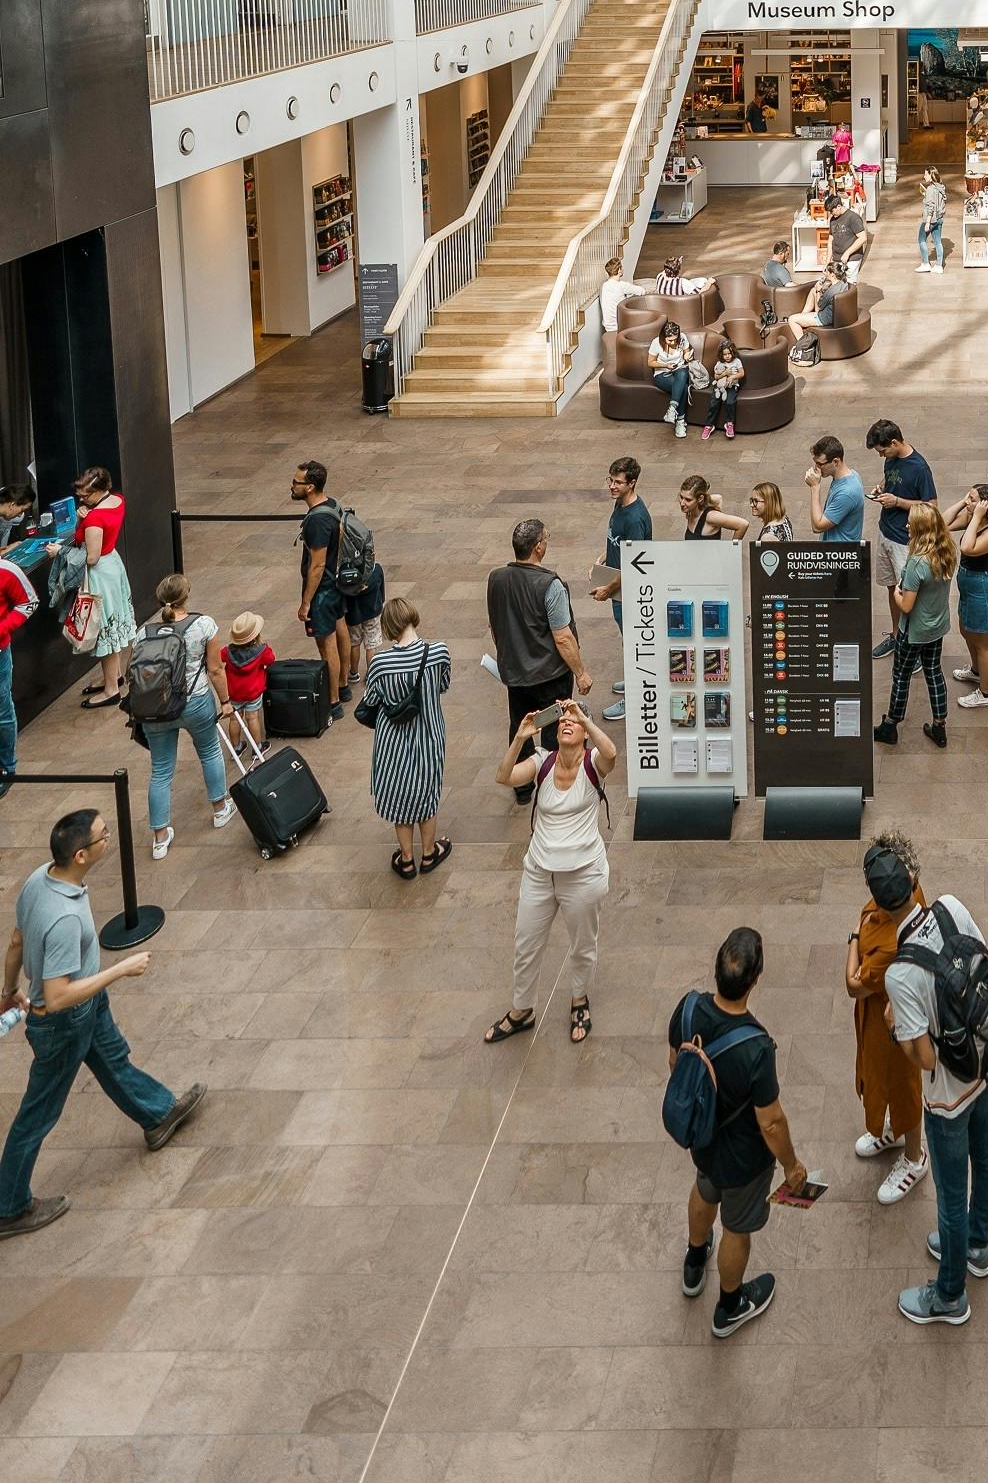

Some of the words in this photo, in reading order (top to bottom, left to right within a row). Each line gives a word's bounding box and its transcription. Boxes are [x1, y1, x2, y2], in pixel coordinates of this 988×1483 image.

[748, 1, 835, 18] Museum
[842, 0, 895, 22] Shop
[786, 551, 824, 560] GUIDED
[825, 551, 858, 560] TOURS
[787, 561, 861, 570] RUNDVISNINGER
[633, 584, 655, 661] Tickets
[635, 666, 657, 676] /
[638, 680, 660, 769] Billetter
